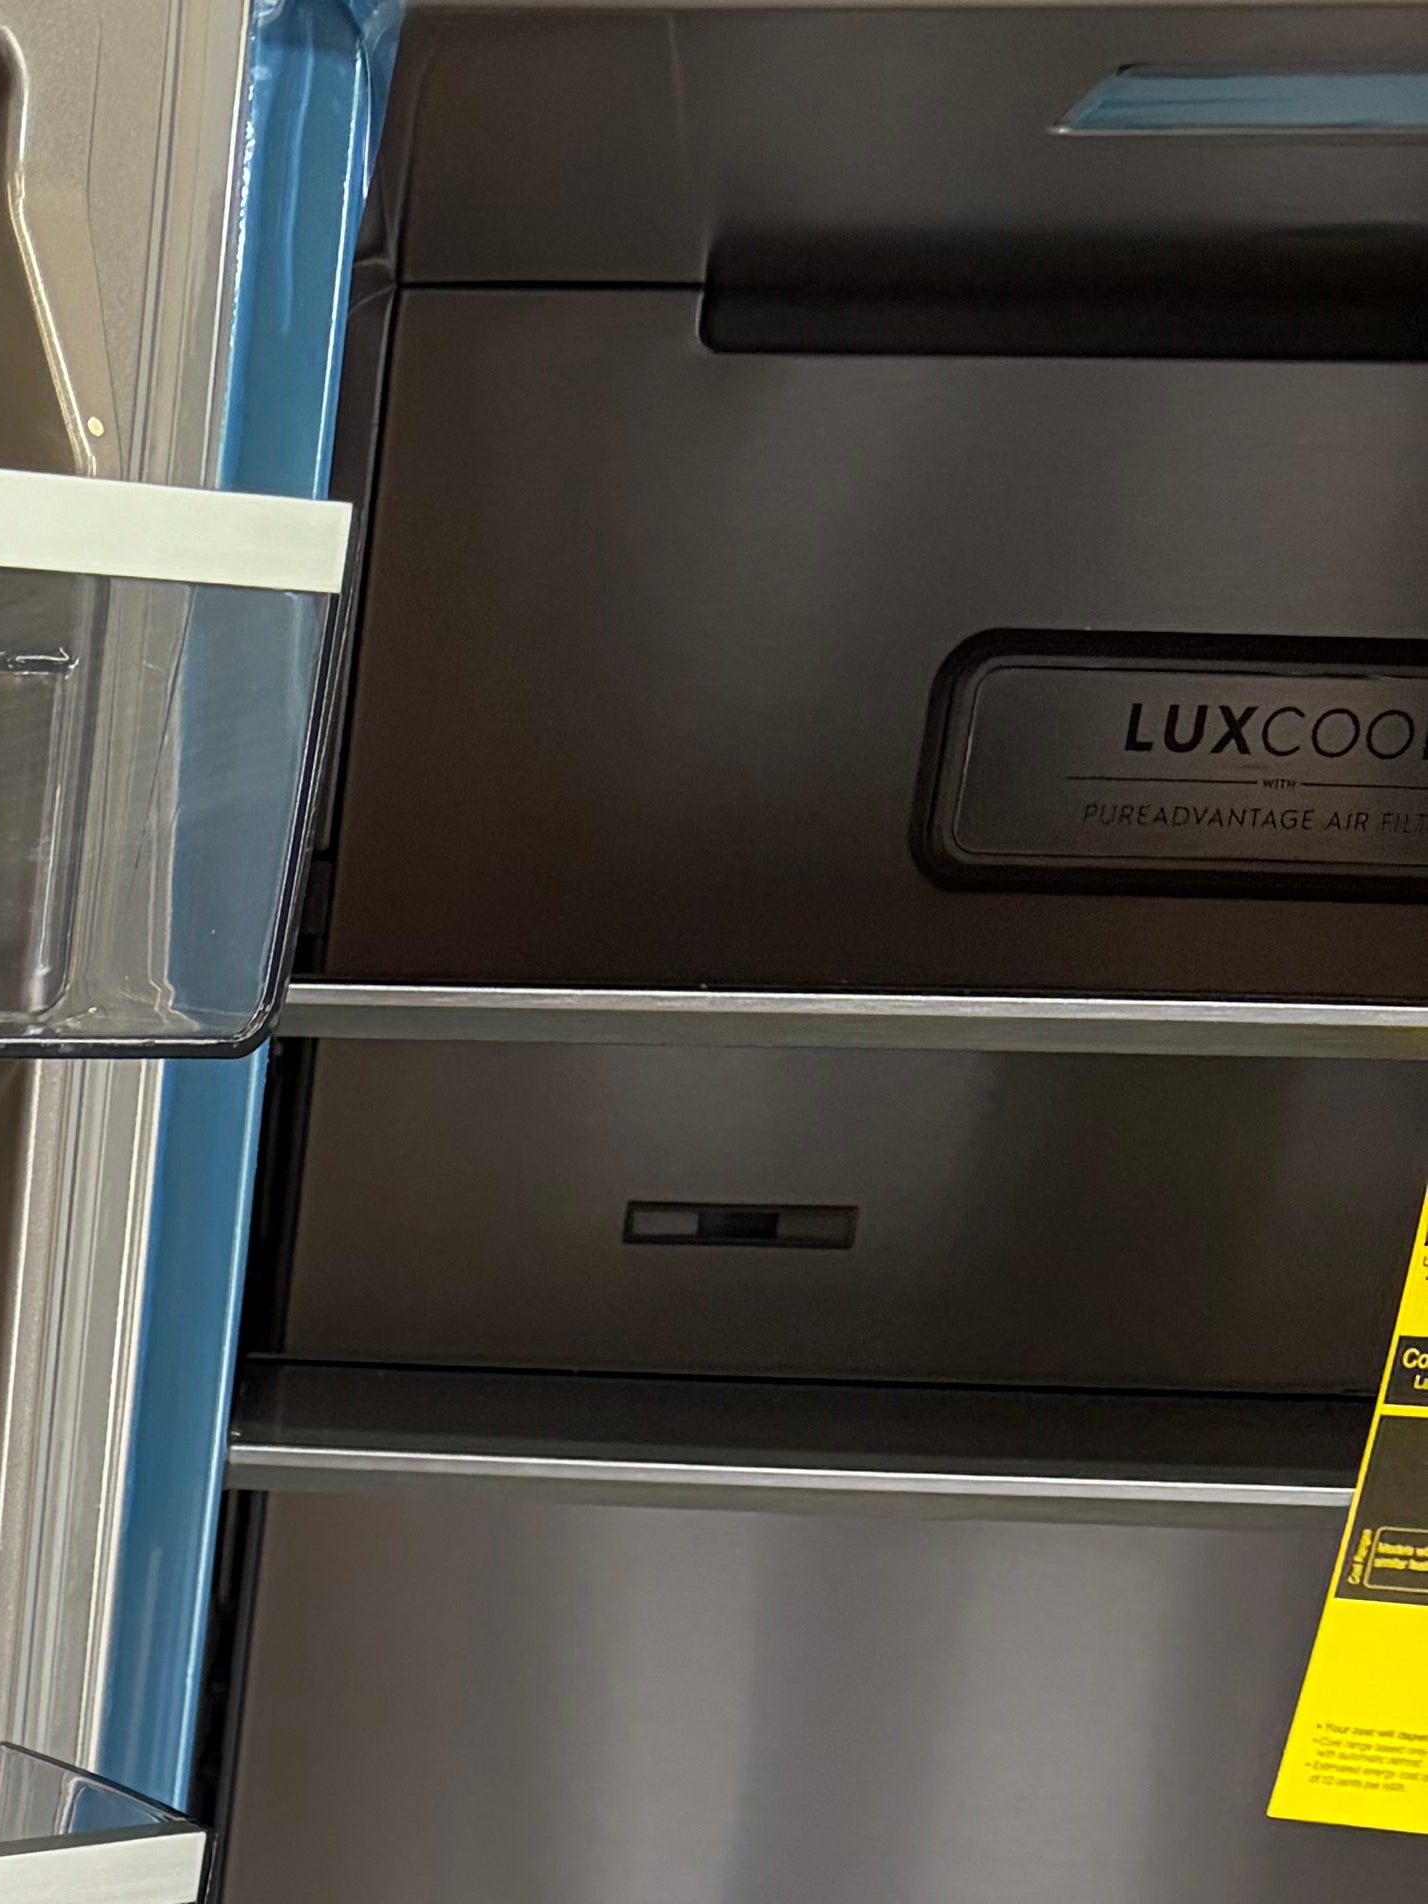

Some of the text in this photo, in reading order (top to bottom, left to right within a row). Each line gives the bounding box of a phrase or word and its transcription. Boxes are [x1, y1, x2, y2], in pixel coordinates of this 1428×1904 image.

[1262, 778, 1297, 790] WITH
[1083, 803, 1316, 831] PUREADVANTAGE
[1323, 809, 1369, 833] AIR
